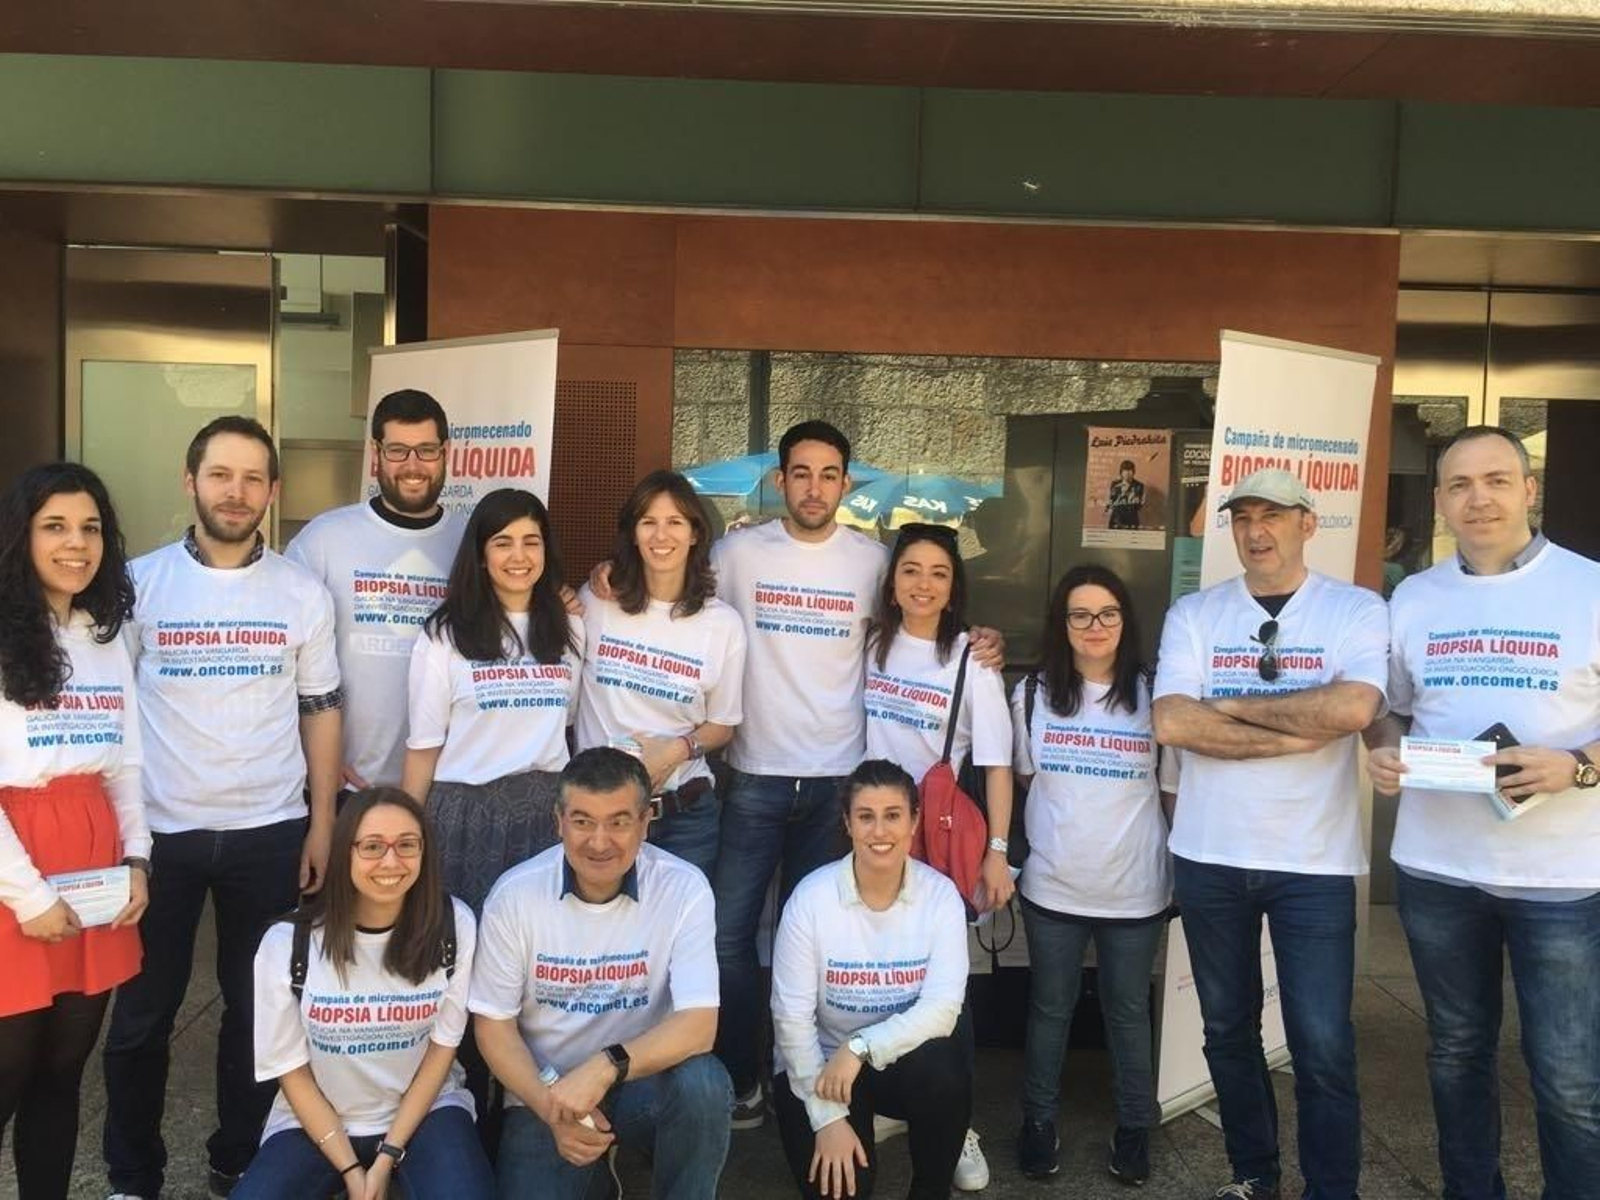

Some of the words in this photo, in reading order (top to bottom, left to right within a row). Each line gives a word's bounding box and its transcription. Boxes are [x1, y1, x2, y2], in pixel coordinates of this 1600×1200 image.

[448, 421, 532, 440] icromecenado
[1224, 426, 1270, 450] Campaña
[1272, 432, 1285, 449] de
[1286, 433, 1359, 455] micromecenado
[451, 440, 536, 480] LÍQUIDA
[440, 485, 474, 499] GARDA
[353, 580, 412, 596] BIOPSIA
[415, 582, 451, 599] LÍQU
[755, 591, 803, 607] BIOPSIA
[806, 594, 854, 612] LÍQUIDA
[157, 620, 201, 630] Campaña
[203, 619, 215, 629] de
[353, 613, 427, 626] www.onco
[755, 620, 850, 638] www.oncomet.es
[157, 631, 221, 646] BIOPSIA
[225, 627, 287, 646] LÍQUIDA
[1468, 628, 1479, 637] de
[1481, 627, 1561, 641] micromecenado
[1426, 639, 1485, 657] BIOPSIA
[1489, 636, 1559, 658] LÍQUIDA
[158, 663, 283, 677] www.oncomet.es
[597, 643, 648, 667] BIOPSIA
[651, 655, 701, 680] LÍQUIDA
[472, 667, 529, 683] BIOPSIA
[1423, 675, 1559, 692] www.oncomet.es
[596, 675, 694, 704] www.oncomet.es
[900, 686, 948, 708] LÍQUIDA
[1043, 732, 1095, 747] BIOPSIA
[1100, 734, 1150, 753] LÍQUIDA
[1040, 761, 1149, 779] www.oncomet.es
[576, 957, 587, 966] de
[865, 961, 876, 969] de
[535, 964, 593, 984] BIOPSIA
[826, 970, 882, 986] BIOPSIA
[884, 968, 927, 985] LÍQUID
[310, 993, 351, 1004] ampaña
[353, 994, 365, 1004] de
[535, 995, 649, 1014] www.oncomet.es
[377, 1001, 439, 1022] LÍQUIDA
